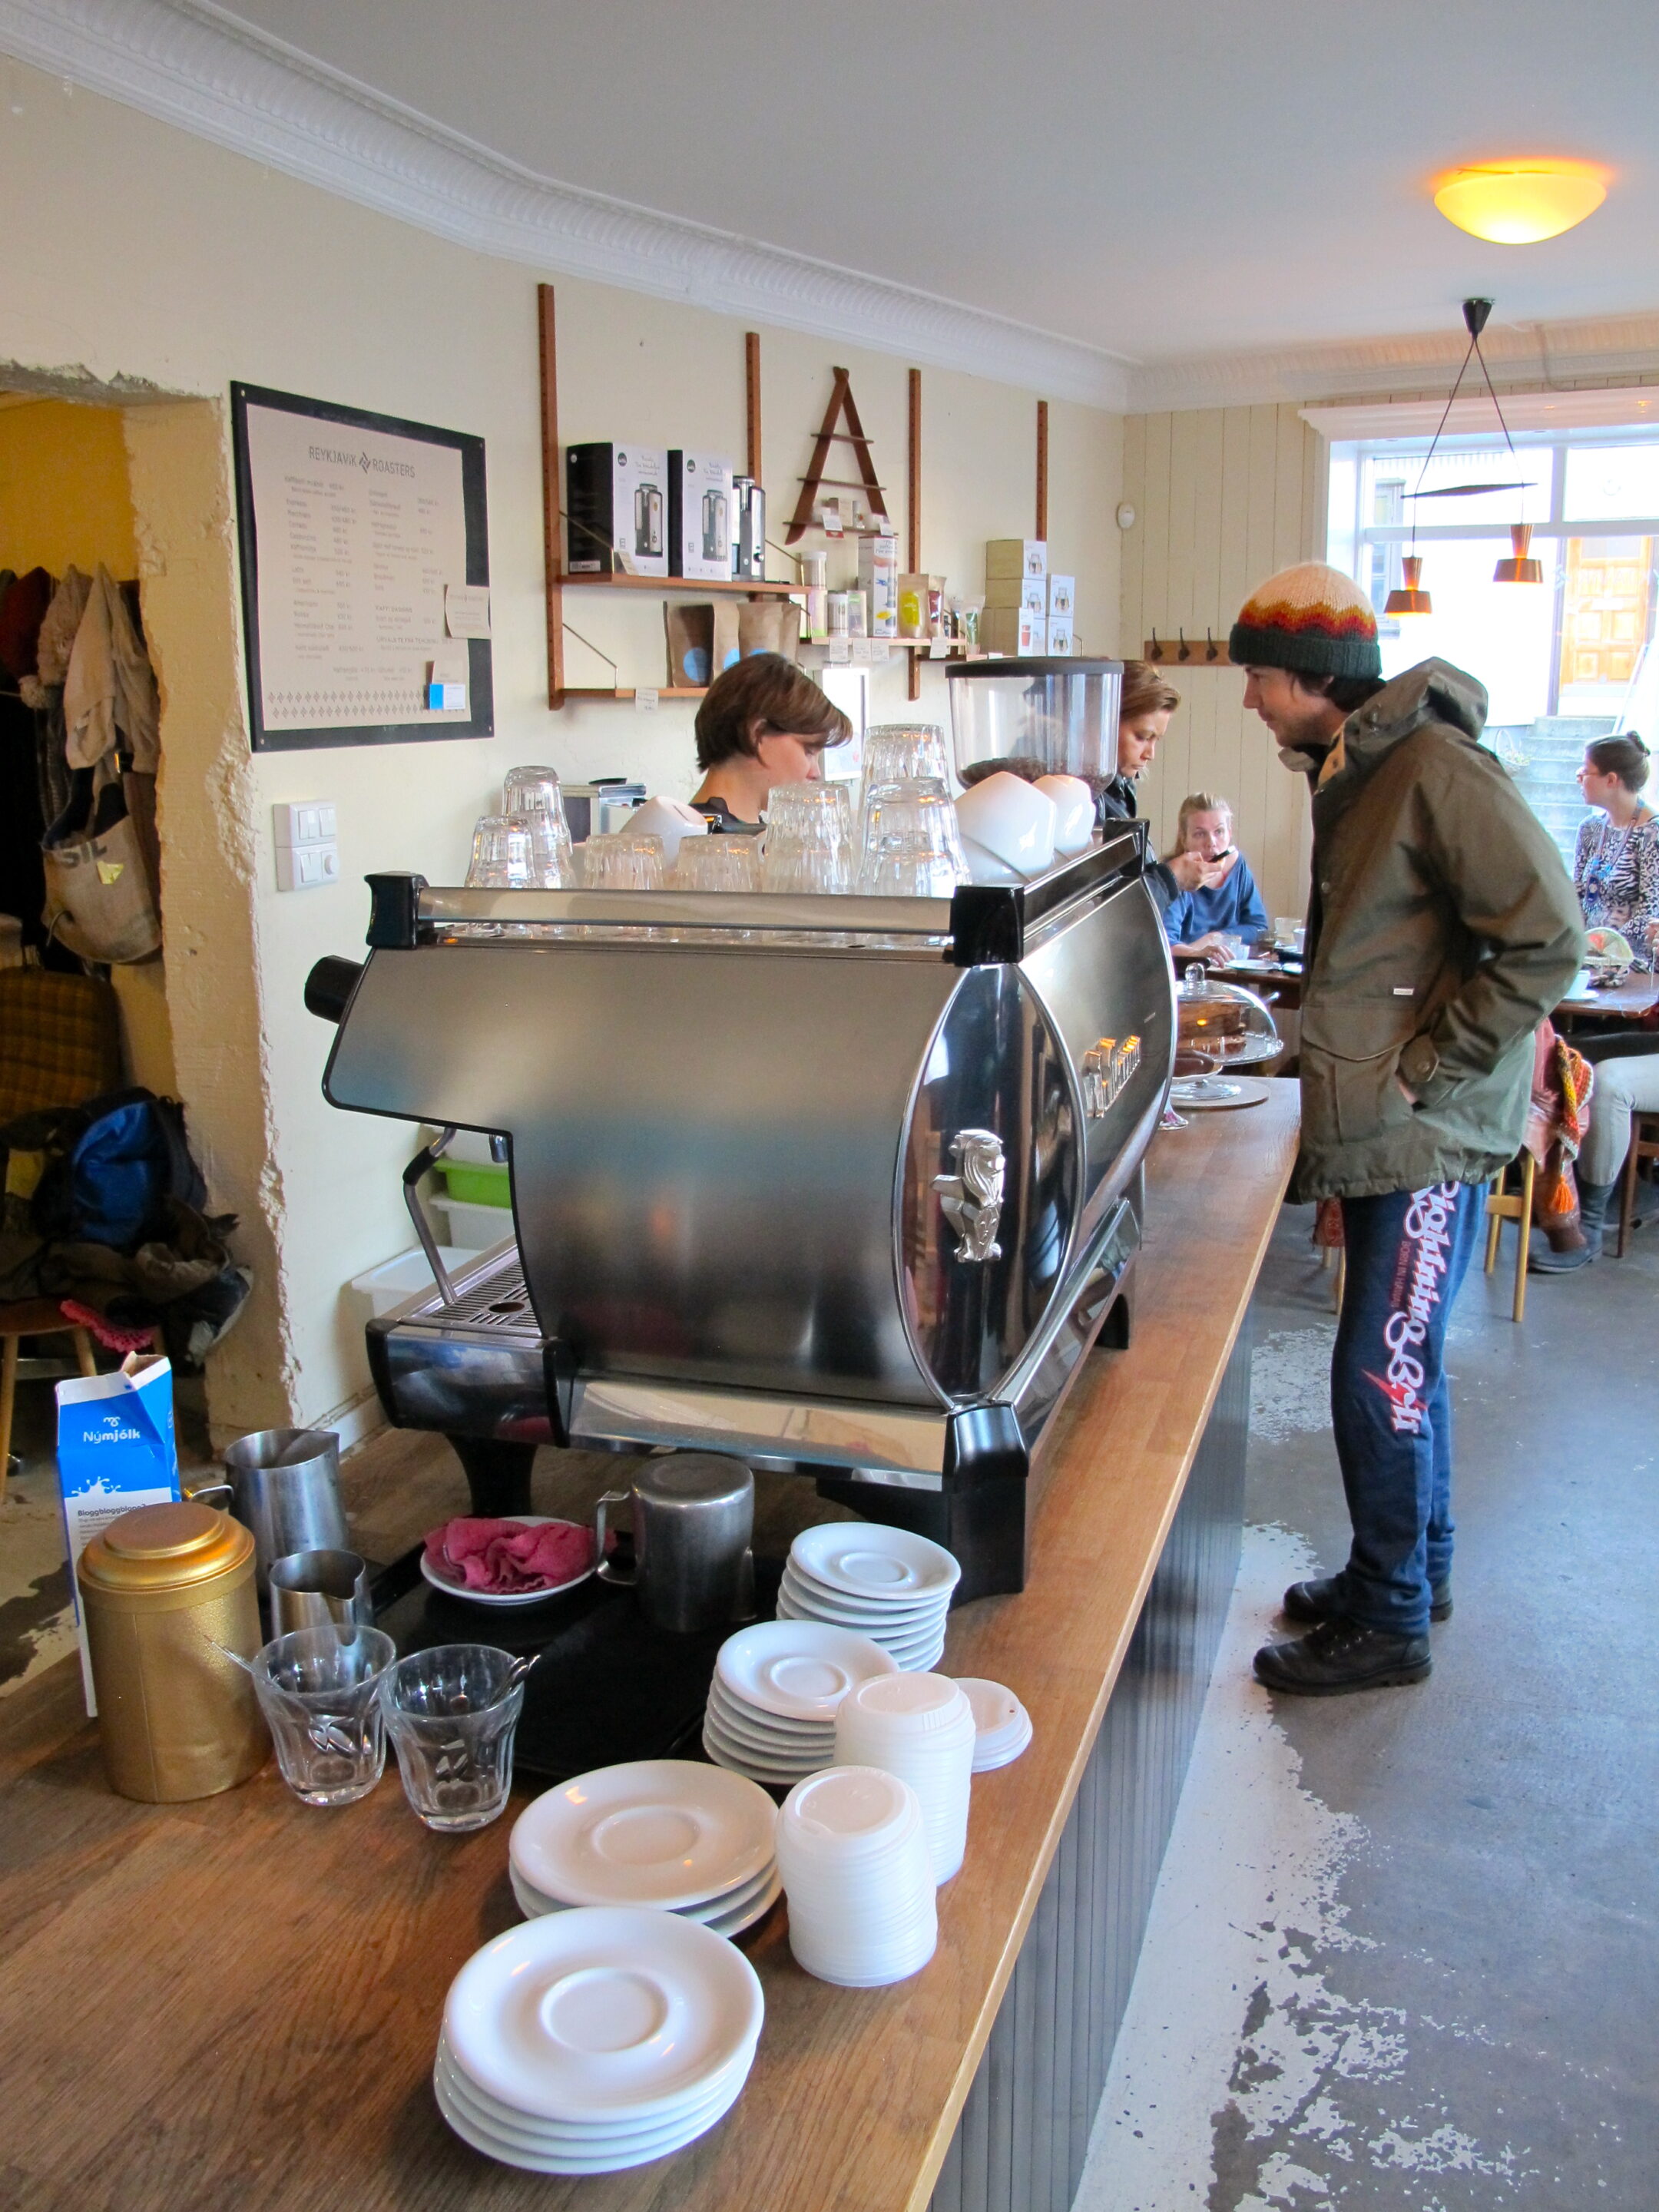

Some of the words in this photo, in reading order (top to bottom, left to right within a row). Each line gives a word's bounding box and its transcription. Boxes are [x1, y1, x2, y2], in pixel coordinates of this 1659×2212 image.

[372, 458, 416, 478] ROASTERS
[1398, 1240, 1411, 1265] BORN
[1397, 1267, 1406, 1277] IN
[83, 1429, 141, 1444] Nýmjólk
